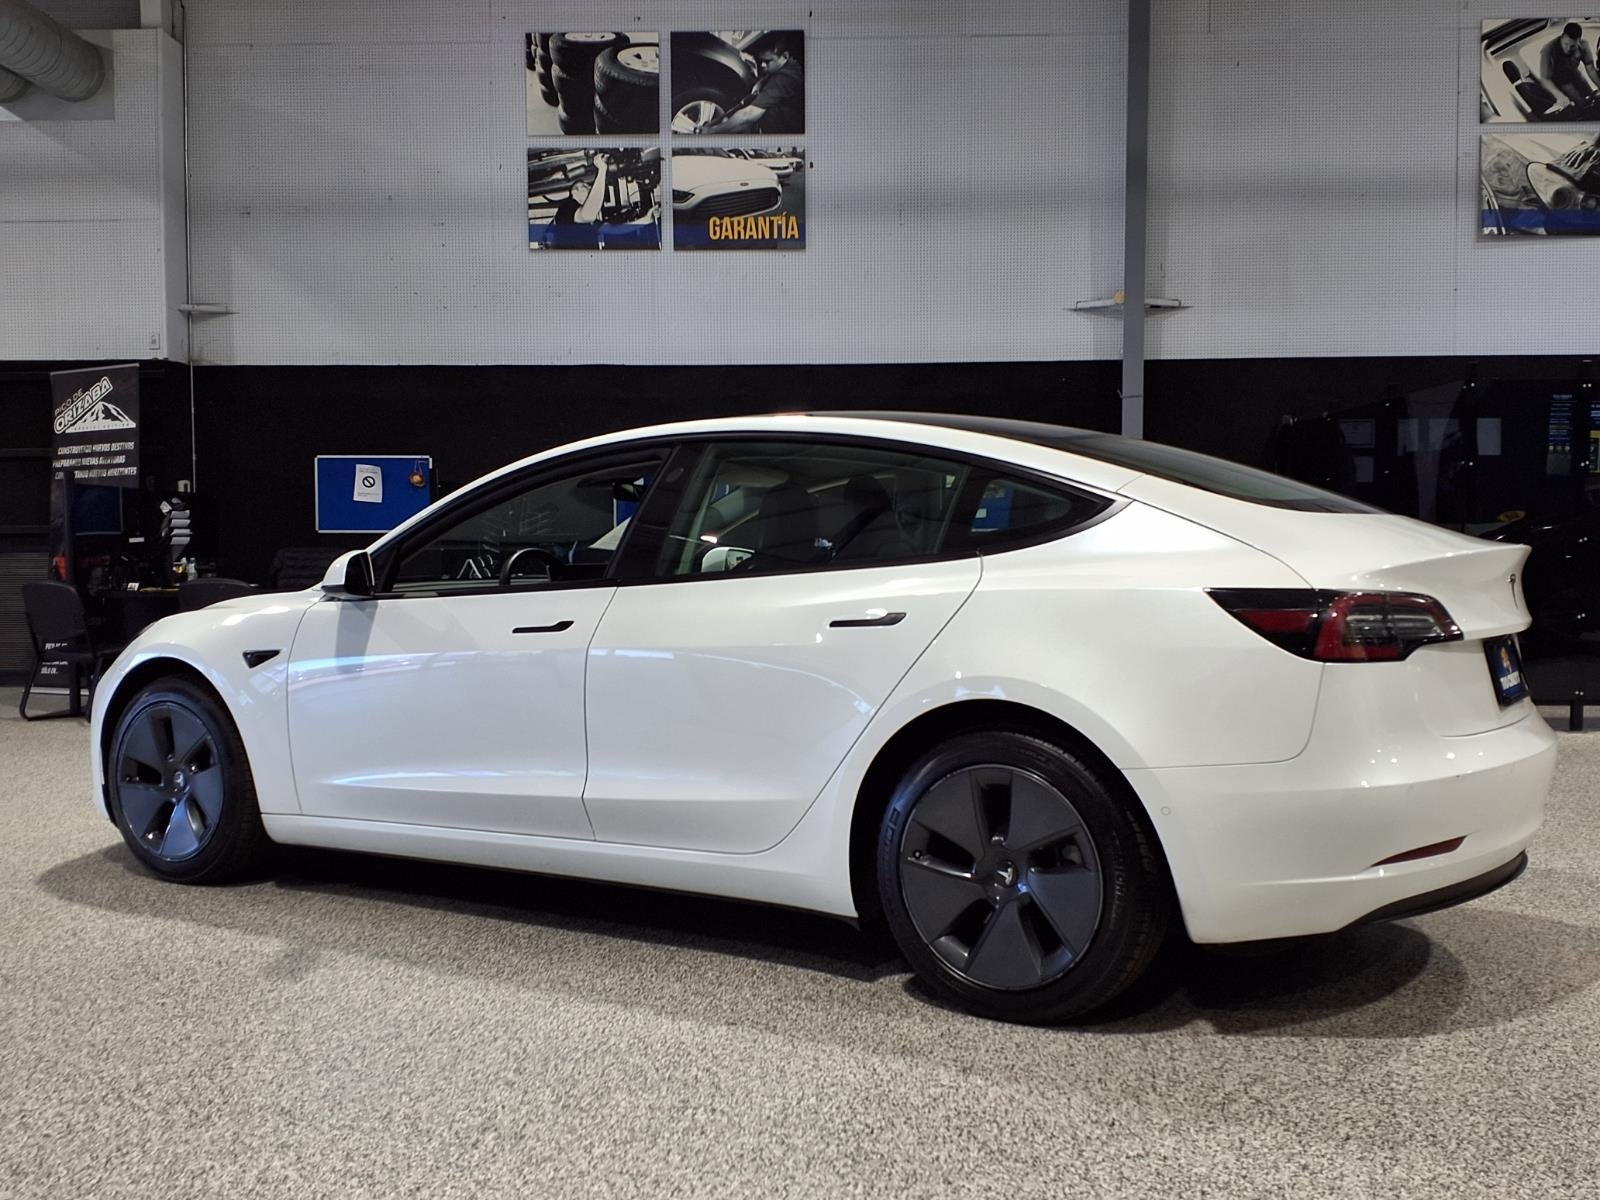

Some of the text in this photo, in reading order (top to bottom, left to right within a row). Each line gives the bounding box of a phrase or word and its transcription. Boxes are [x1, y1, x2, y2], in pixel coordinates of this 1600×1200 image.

[709, 211, 799, 241] GARANTÍA
[54, 376, 113, 434] ORIZABA
[55, 398, 73, 416] PICO
